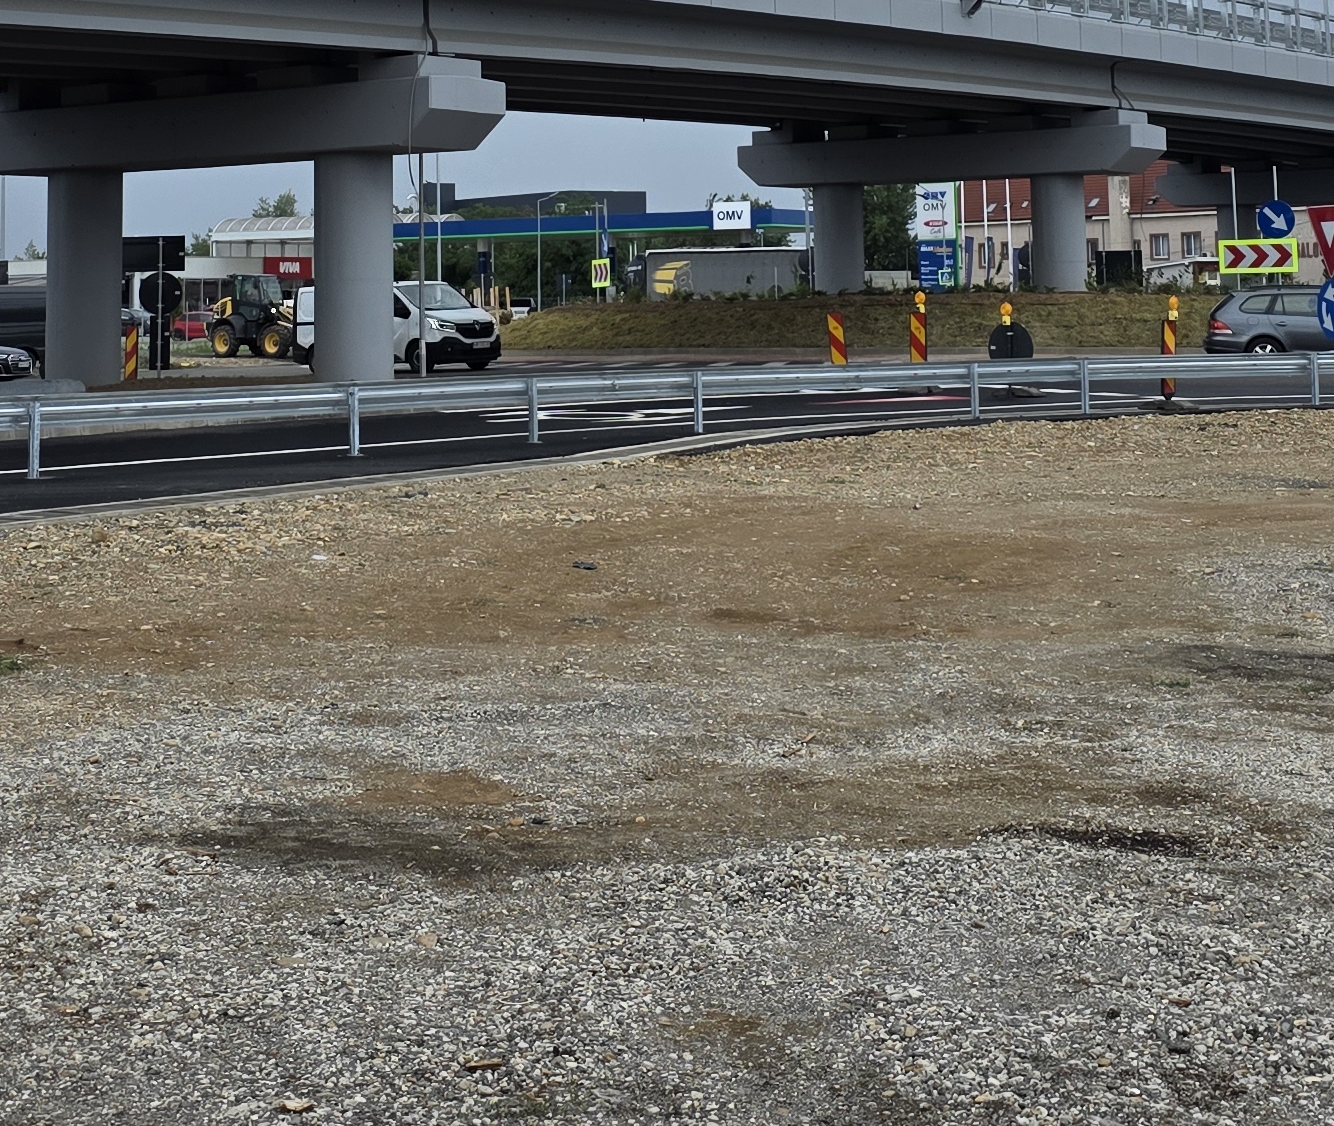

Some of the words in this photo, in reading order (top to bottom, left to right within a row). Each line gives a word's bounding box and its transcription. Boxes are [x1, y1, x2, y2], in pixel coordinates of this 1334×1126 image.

[923, 203, 947, 211] OMV
[717, 210, 743, 220] OMV
[279, 261, 300, 274] VIVA
